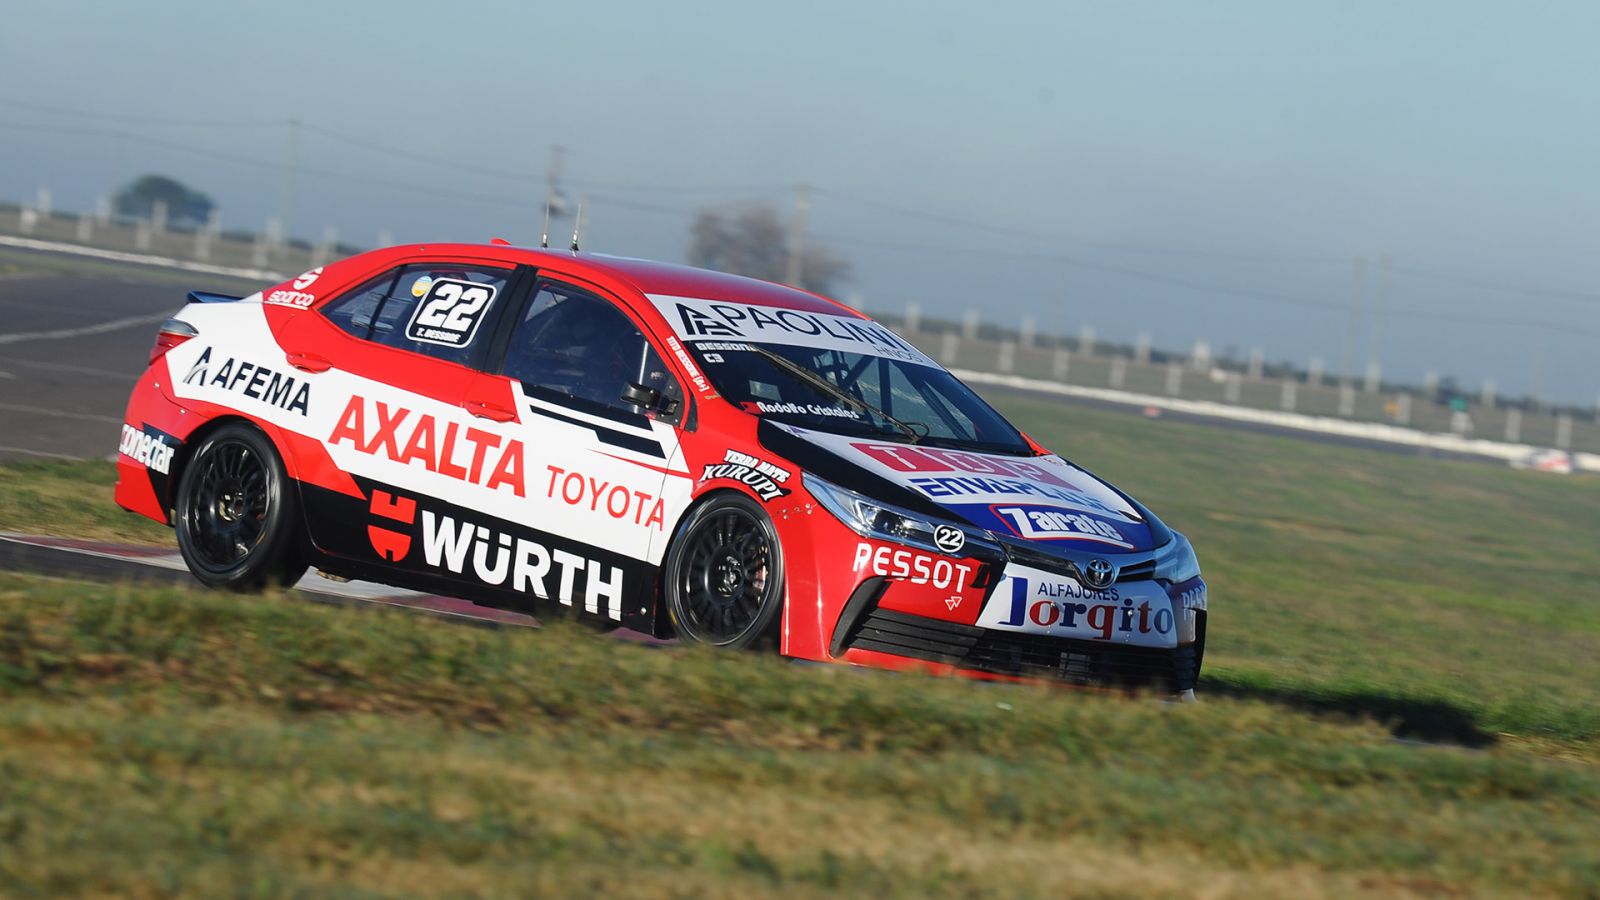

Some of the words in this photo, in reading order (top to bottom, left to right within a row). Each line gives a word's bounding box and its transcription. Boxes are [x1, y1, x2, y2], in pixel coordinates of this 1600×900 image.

[265, 290, 315, 308] sparco
[416, 283, 489, 332] 22
[709, 304, 910, 352] PAOLINI
[210, 357, 311, 417] AFEMA
[756, 401, 807, 414] Rodolfo
[806, 404, 860, 419] Cristales
[119, 424, 175, 475] conectar
[328, 395, 526, 498] AXALTA
[546, 464, 665, 531] TOYOTA
[938, 528, 962, 547] 22
[998, 508, 1134, 549] Zarate
[421, 510, 623, 621] WÜRTH
[853, 543, 971, 592] PESSOT
[1038, 582, 1120, 601] ALFAJORES
